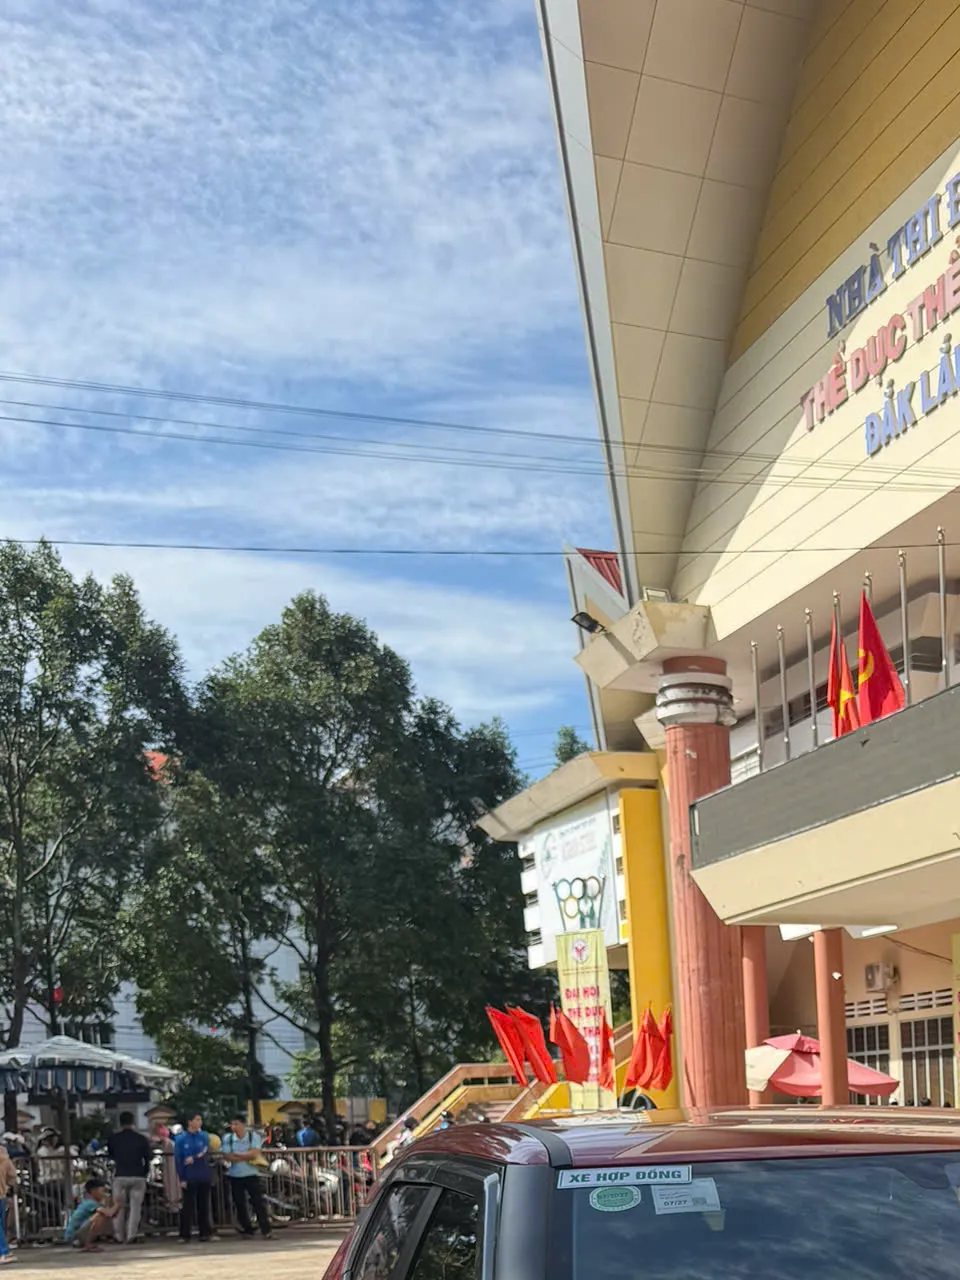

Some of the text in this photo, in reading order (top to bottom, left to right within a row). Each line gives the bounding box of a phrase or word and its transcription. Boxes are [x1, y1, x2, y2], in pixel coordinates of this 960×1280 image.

[826, 242, 887, 338] NHÀ
[887, 193, 943, 279] THI
[800, 340, 848, 432] THỂ
[850, 313, 907, 393] DỤC
[864, 379, 917, 457] ĐẮK
[569, 1173, 590, 1183] XE
[596, 1171, 631, 1183] HỢP
